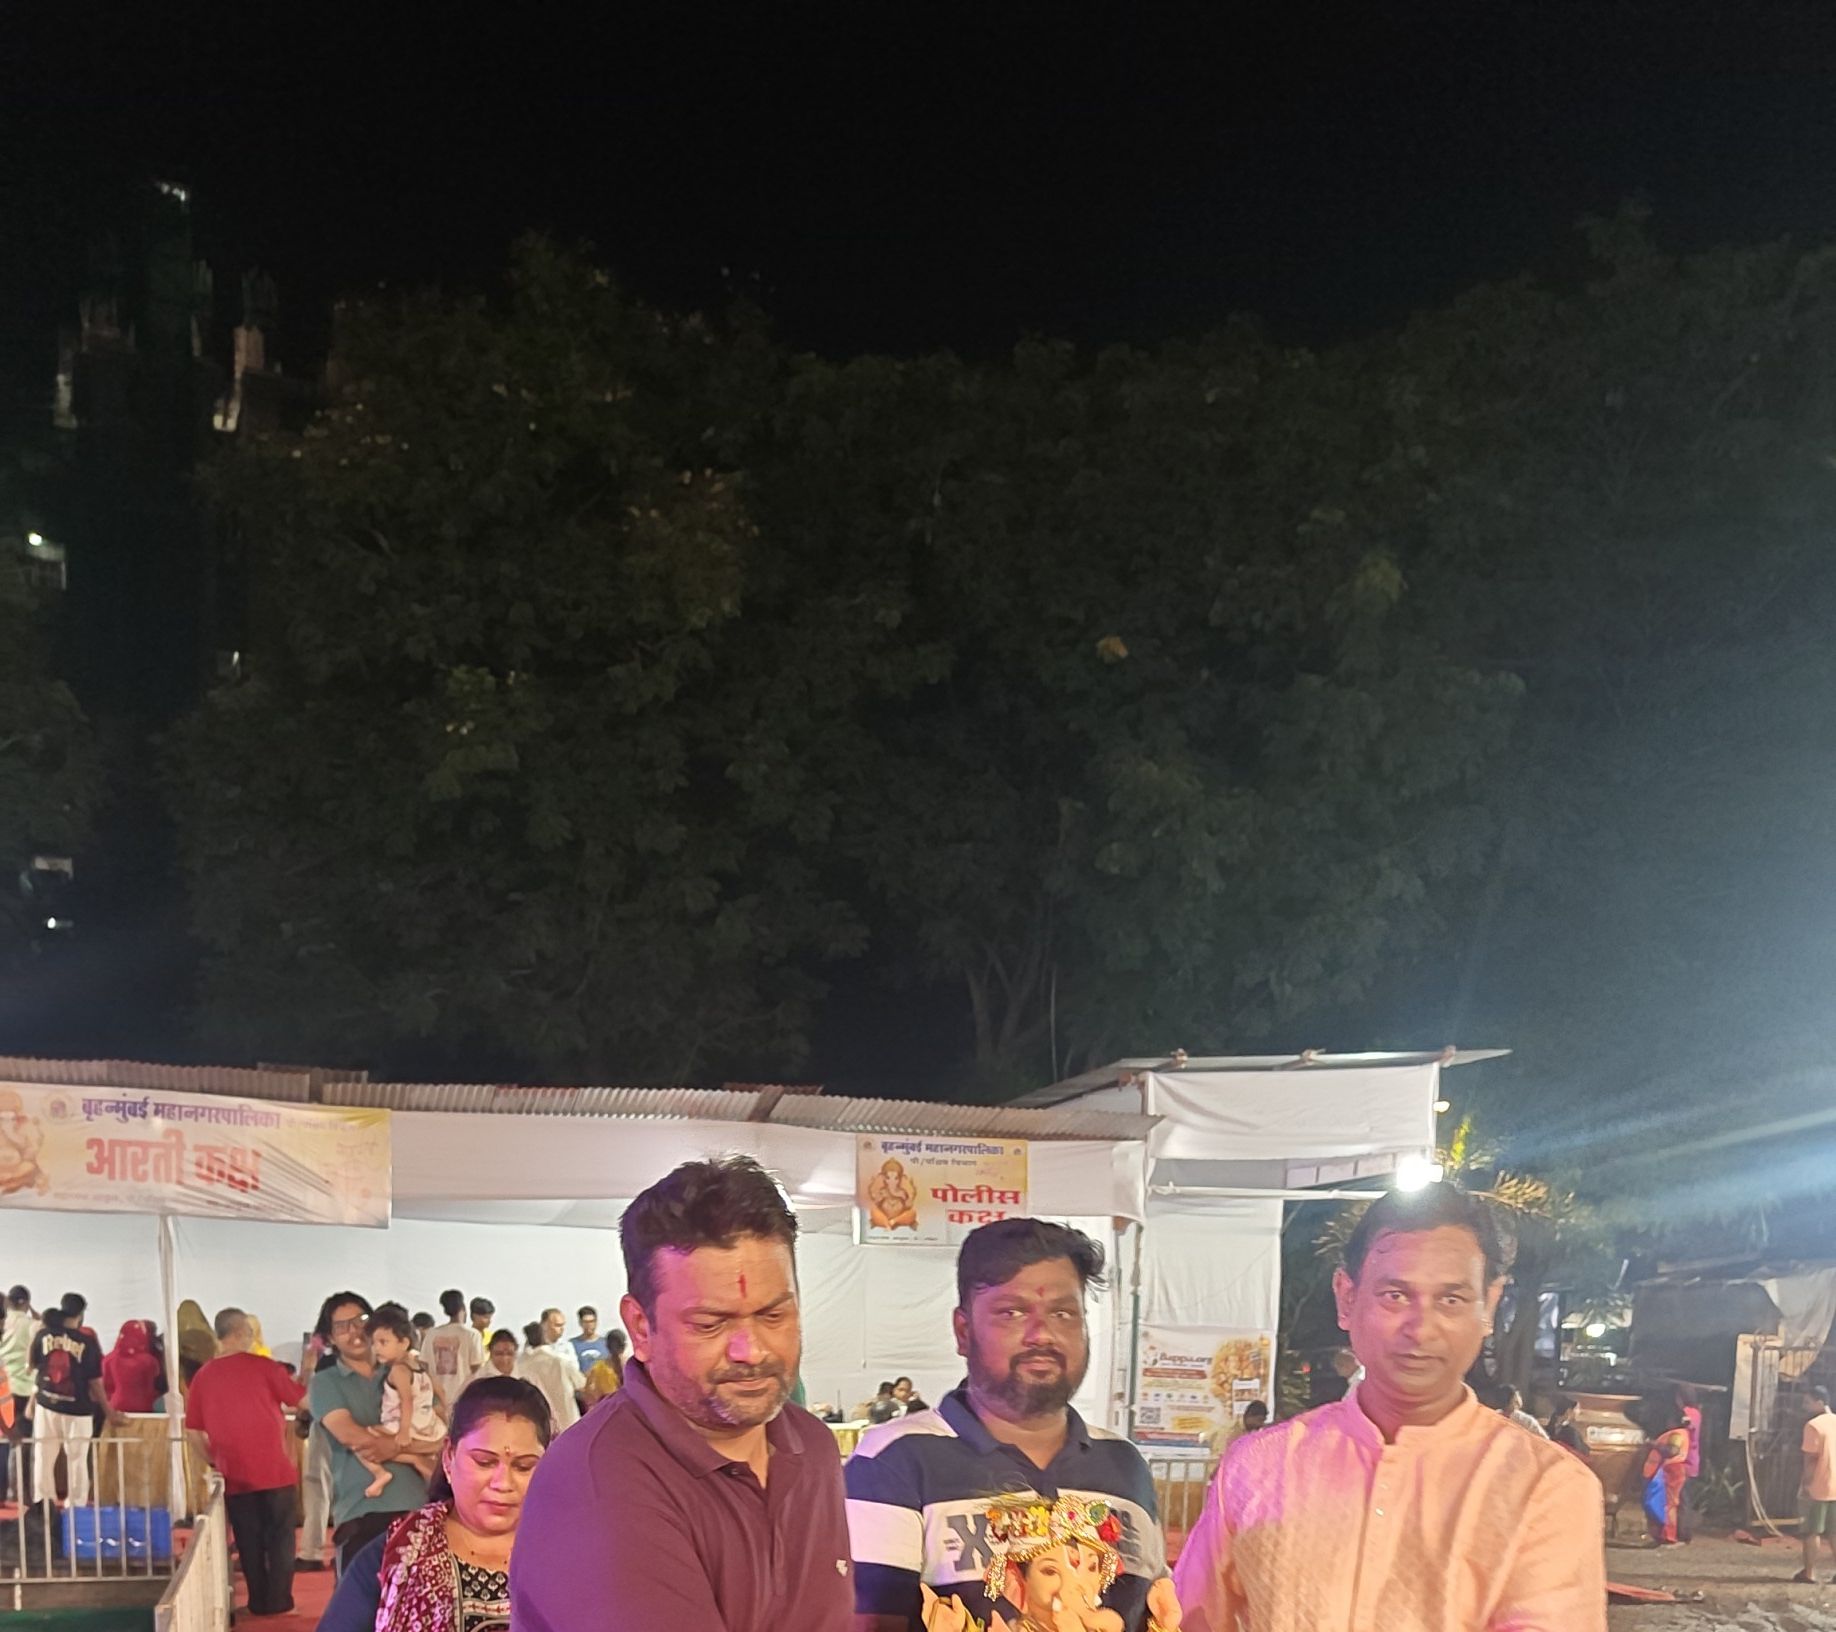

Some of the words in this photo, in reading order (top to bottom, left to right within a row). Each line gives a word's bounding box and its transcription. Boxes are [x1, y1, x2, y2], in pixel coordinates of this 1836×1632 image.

[82, 1093, 150, 1123] बृहन्मुंबई
[154, 1101, 281, 1129] महानगरपालिका
[85, 1129, 184, 1184] आरती
[193, 1142, 263, 1193] कक्ष
[930, 1183, 1022, 1204] पोलीस
